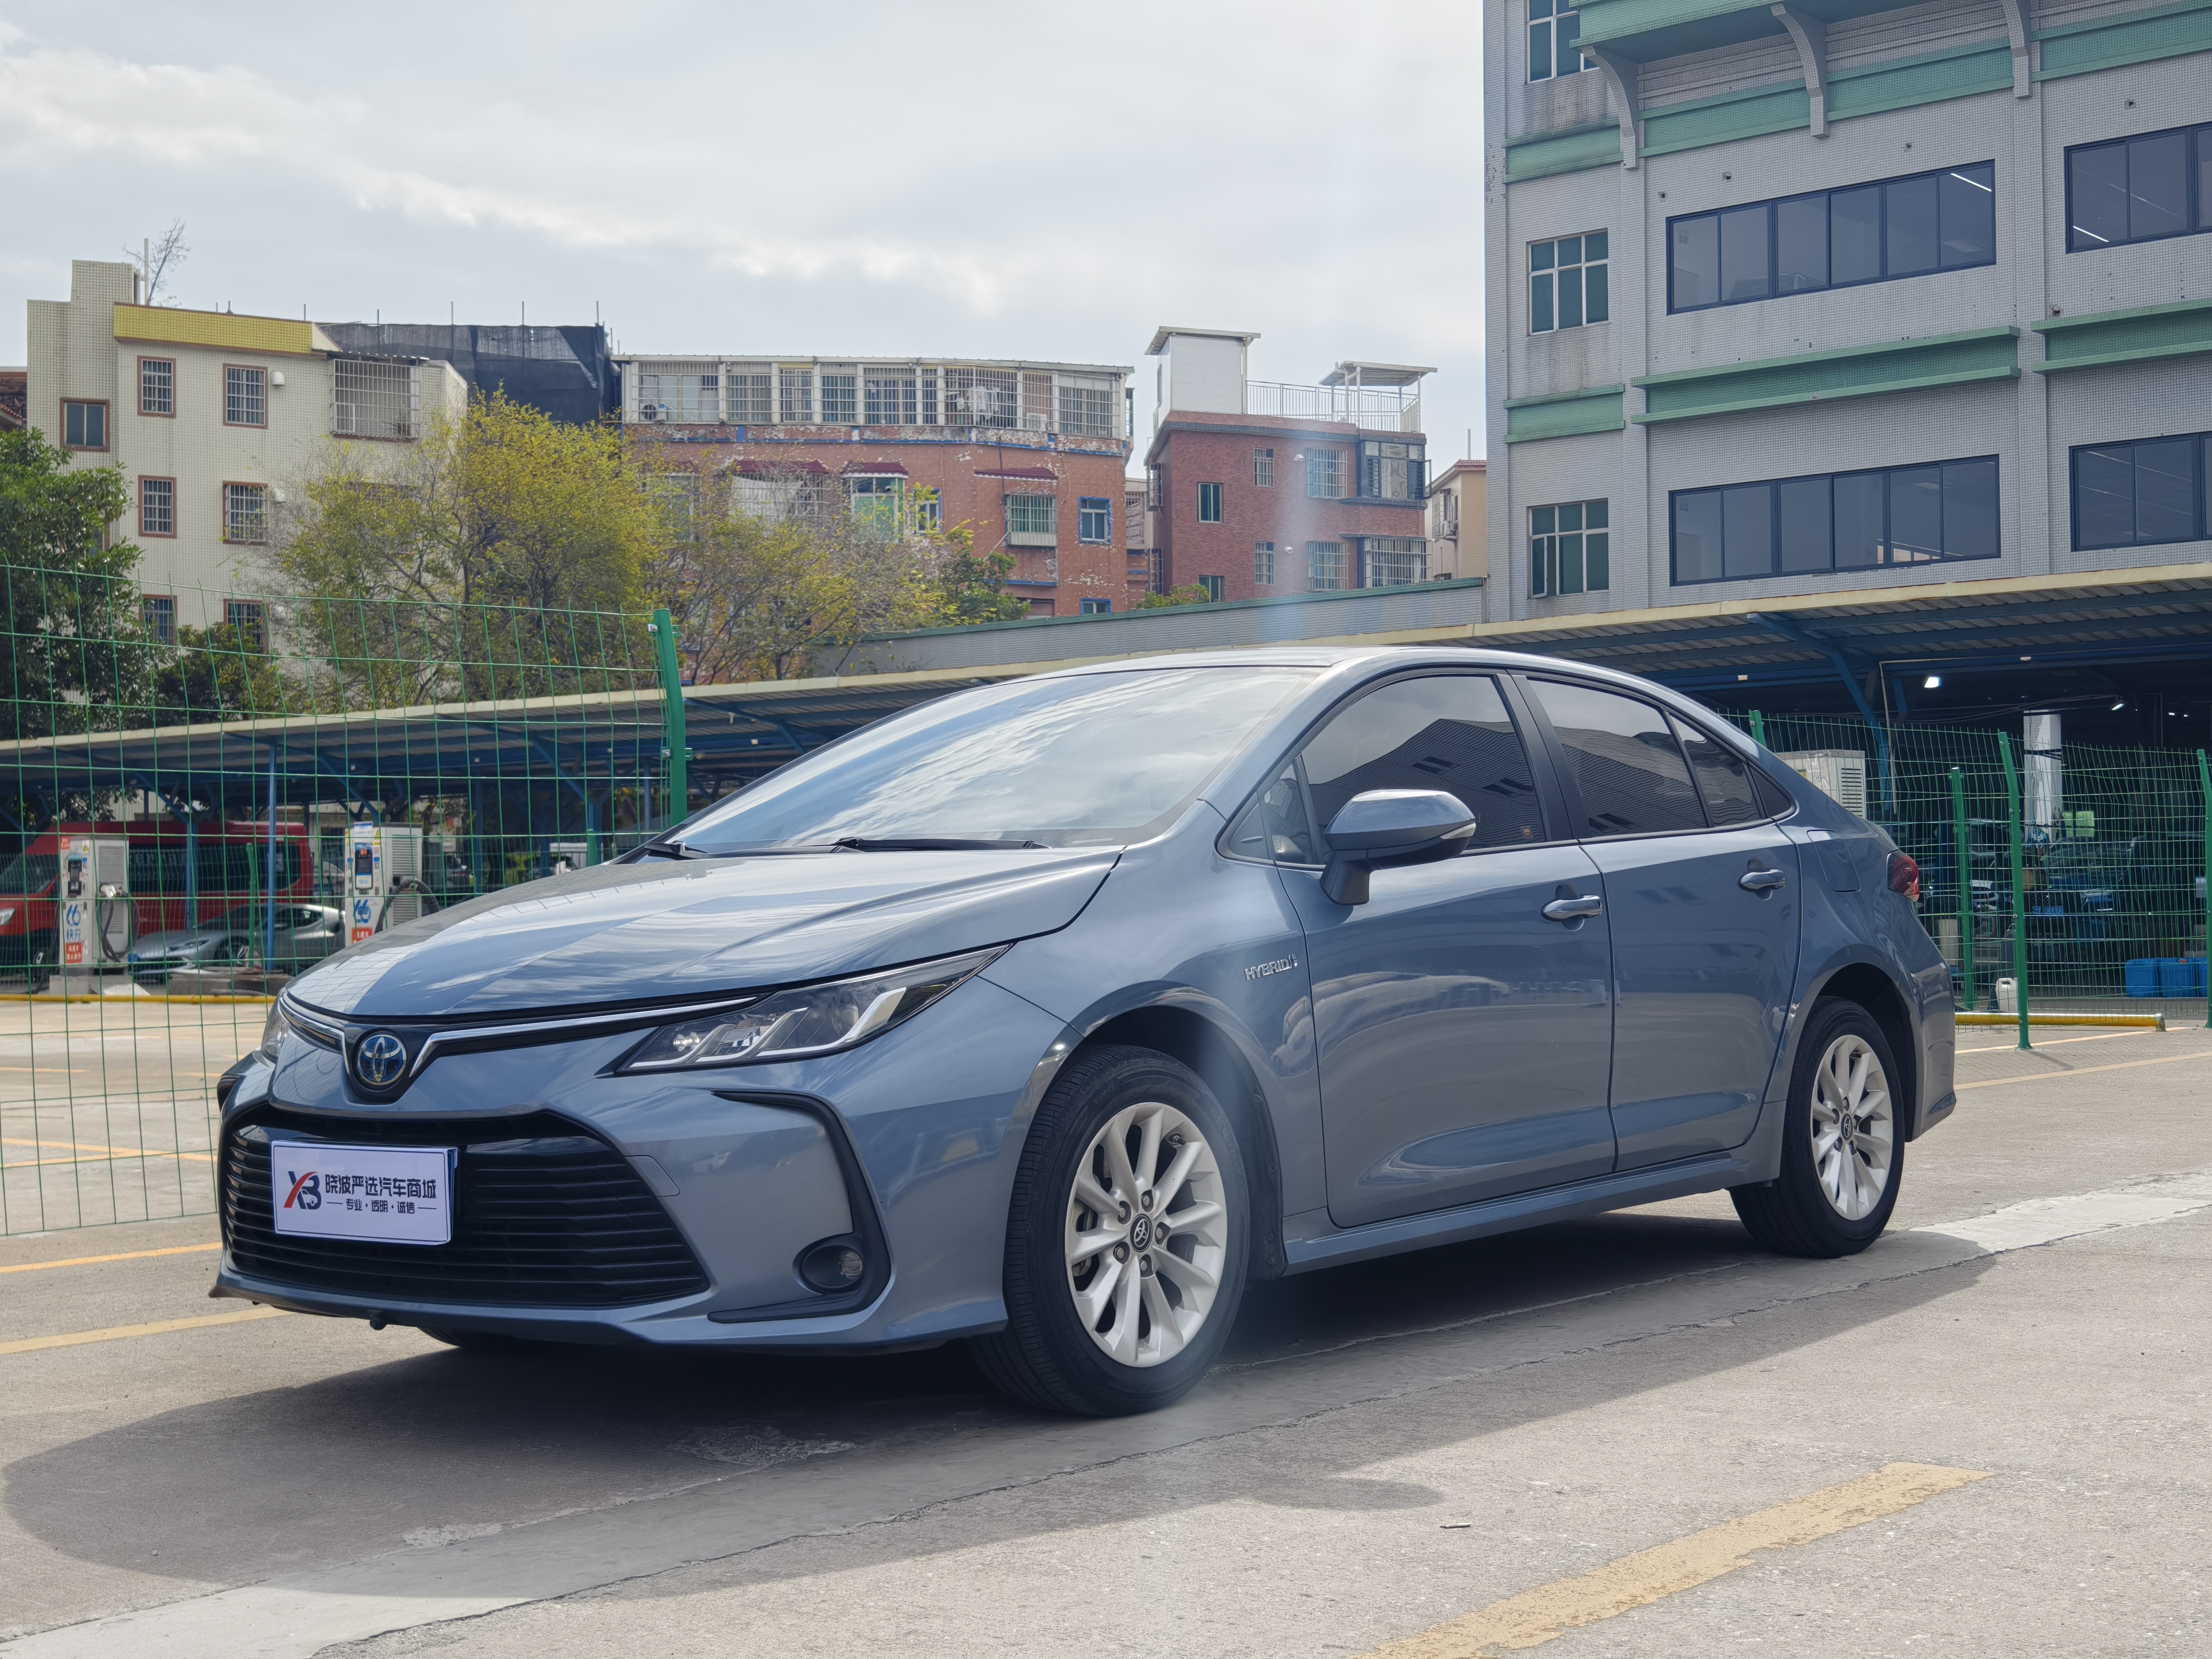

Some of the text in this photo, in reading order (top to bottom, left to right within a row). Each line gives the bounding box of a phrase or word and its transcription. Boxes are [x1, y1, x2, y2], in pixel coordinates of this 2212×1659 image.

[1244, 958, 1292, 981] HYBRID
[325, 1174, 437, 1199] 晓波严选汽车商城
